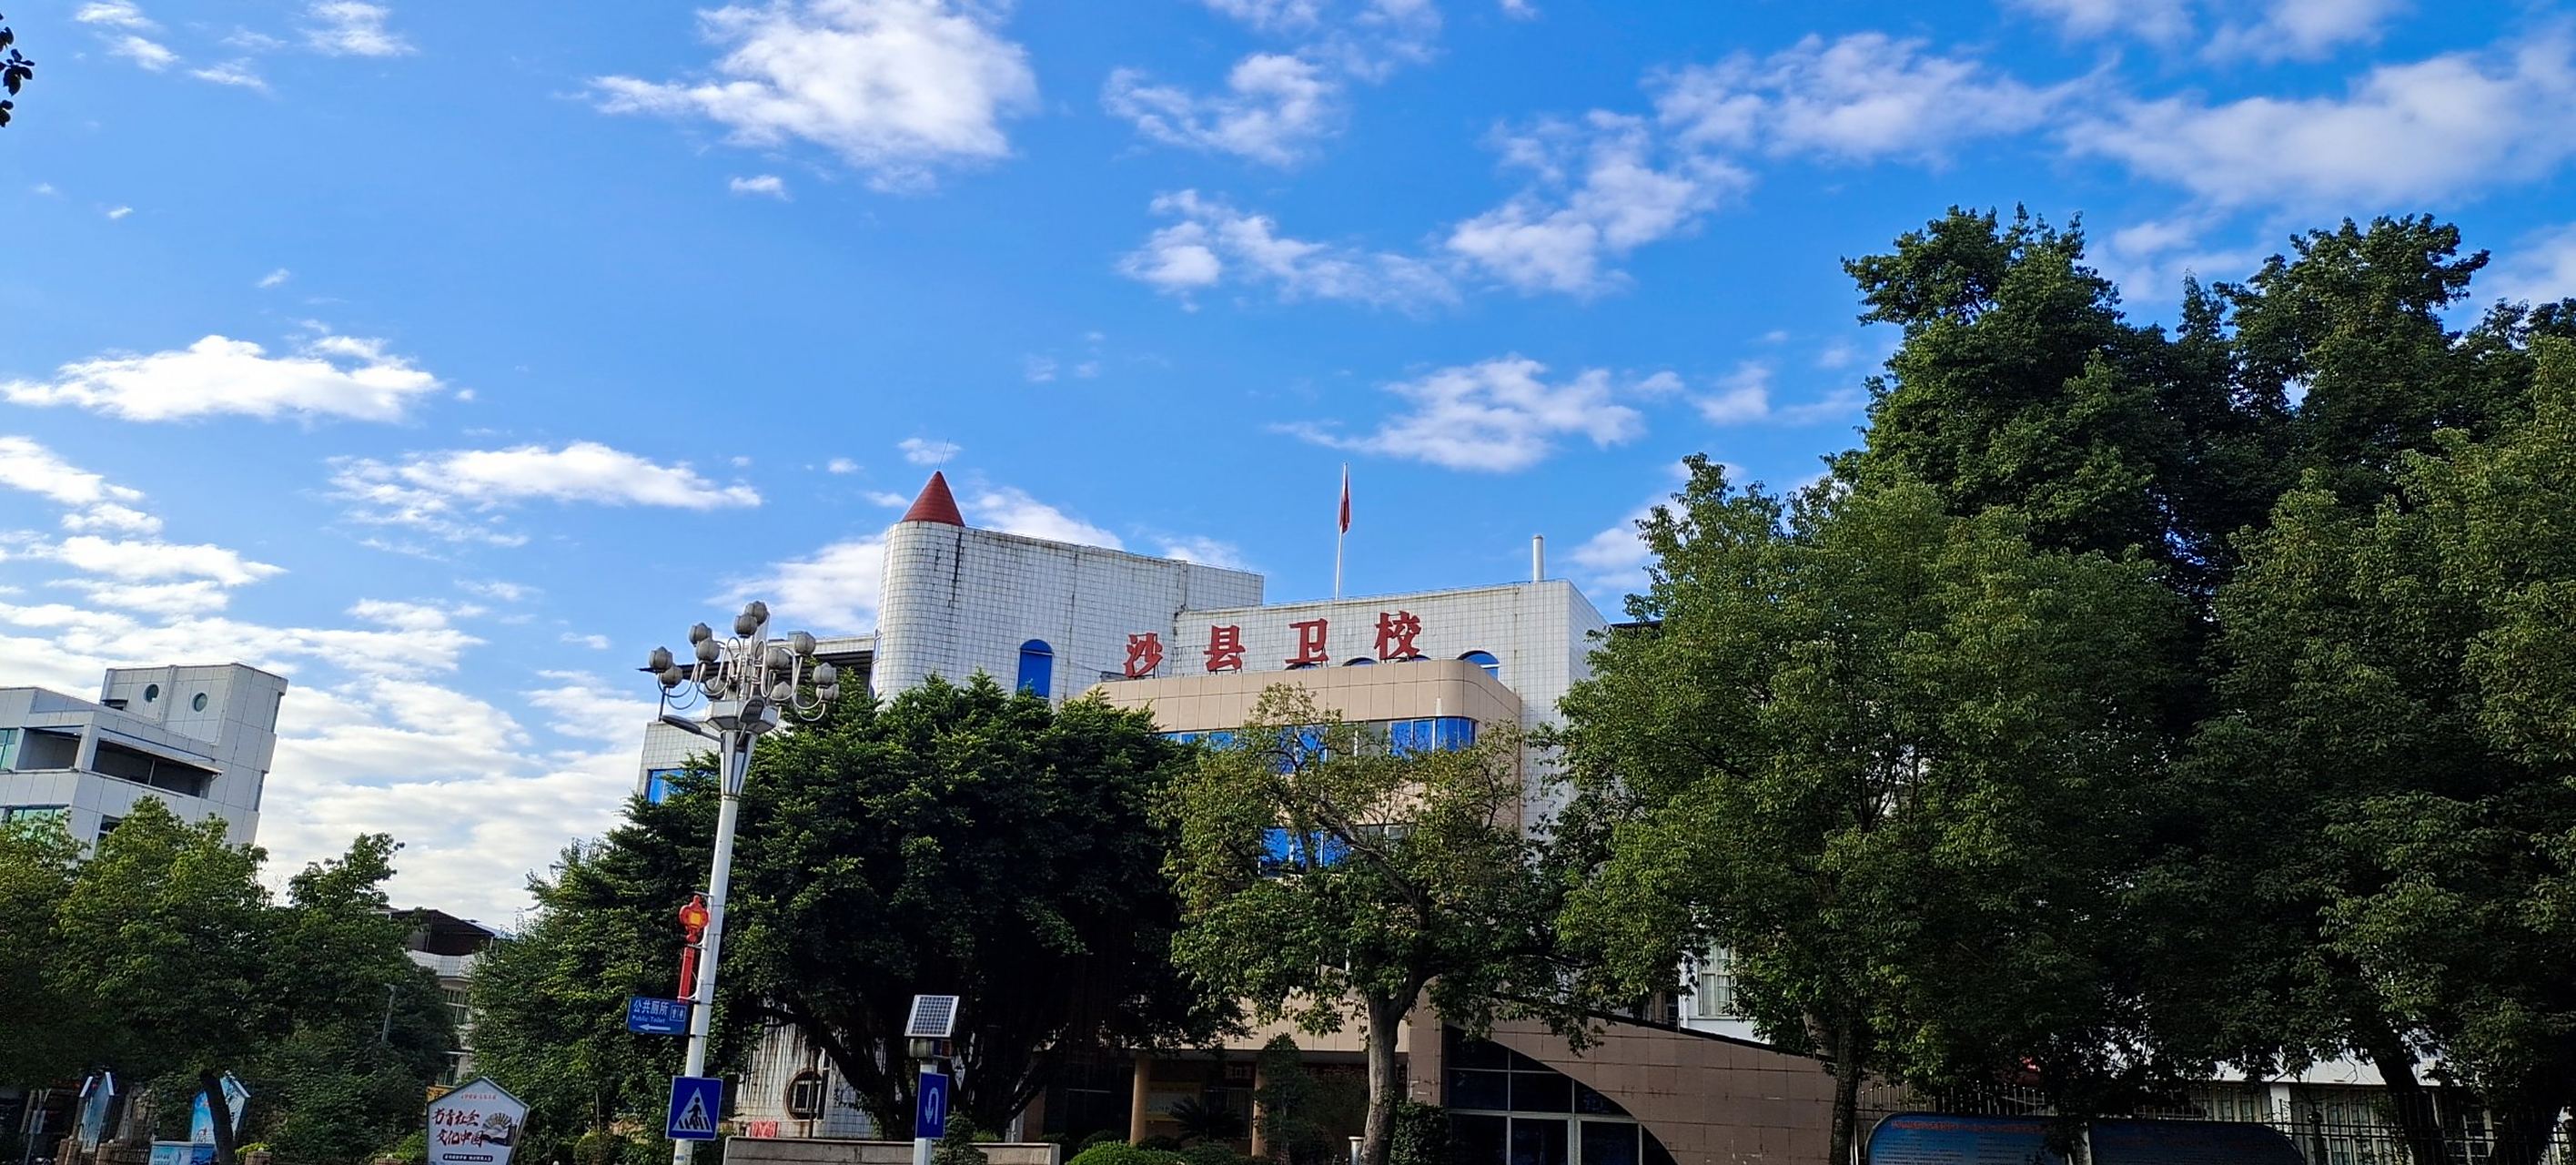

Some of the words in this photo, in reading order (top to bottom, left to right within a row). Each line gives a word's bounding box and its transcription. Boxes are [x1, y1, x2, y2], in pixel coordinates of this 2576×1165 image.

[1124, 610, 1422, 677] 沙县卫校
[634, 999, 670, 1016] 公共厕所
[631, 1015, 648, 1023] Public
[651, 1017, 665, 1025] Toilet
[437, 1129, 484, 1149] 文化中国
